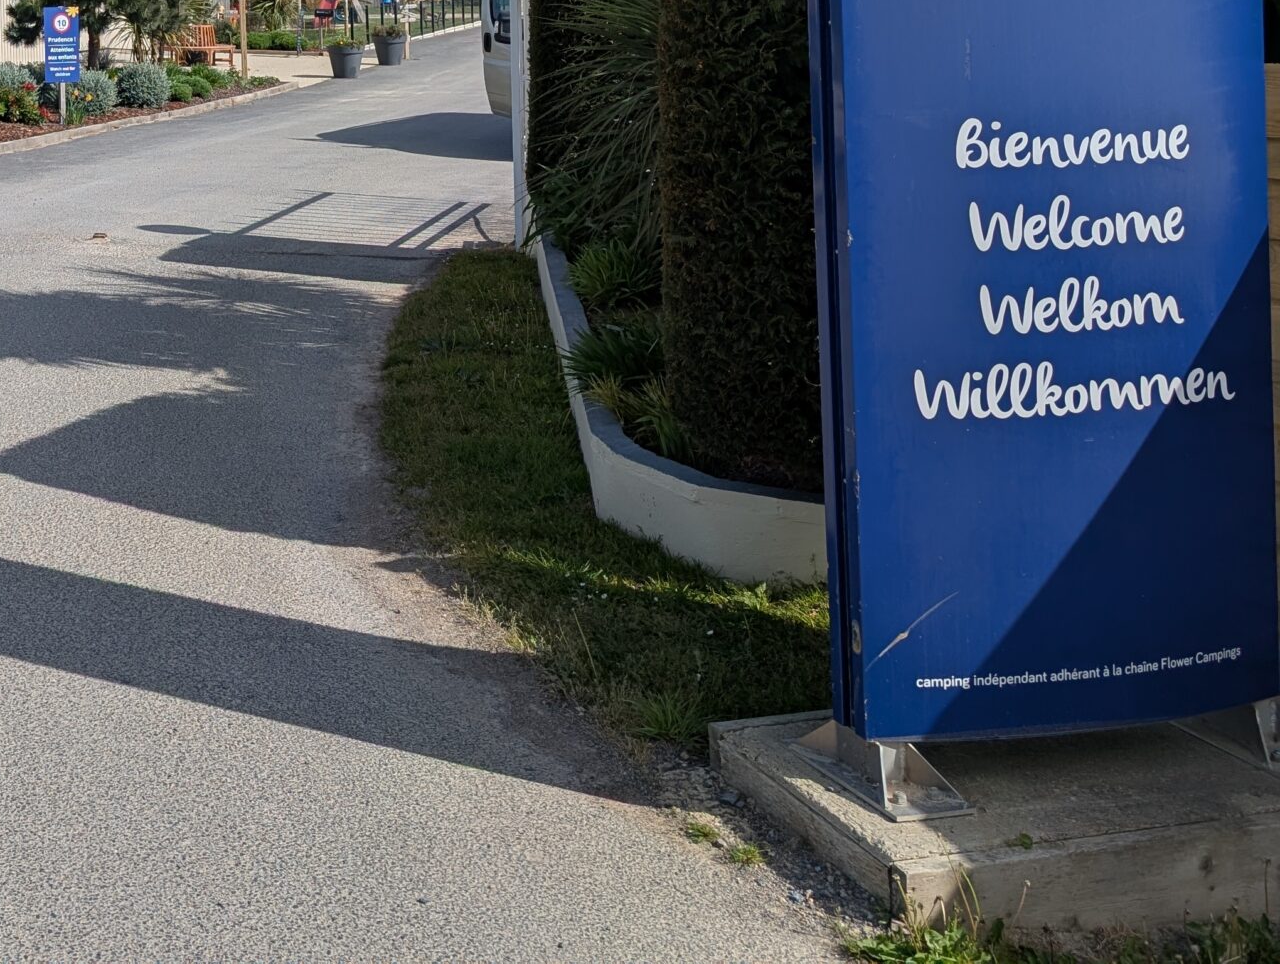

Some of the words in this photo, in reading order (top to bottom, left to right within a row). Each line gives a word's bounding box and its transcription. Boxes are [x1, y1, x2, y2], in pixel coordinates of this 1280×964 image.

[57, 19, 67, 27] 10
[955, 117, 1190, 170] Bienvenue
[969, 194, 1185, 252] Welcome
[979, 275, 1185, 335] Welkom
[913, 361, 1236, 420] Willkommen
[915, 675, 971, 689] camping
[973, 670, 1048, 687] indépendant
[1050, 667, 1100, 683] adhérant
[1102, 664, 1111, 677] à
[1112, 663, 1122, 676] la
[1124, 660, 1159, 675] chaîne
[1161, 654, 1194, 671] Flower
[1195, 646, 1242, 666] Campings
